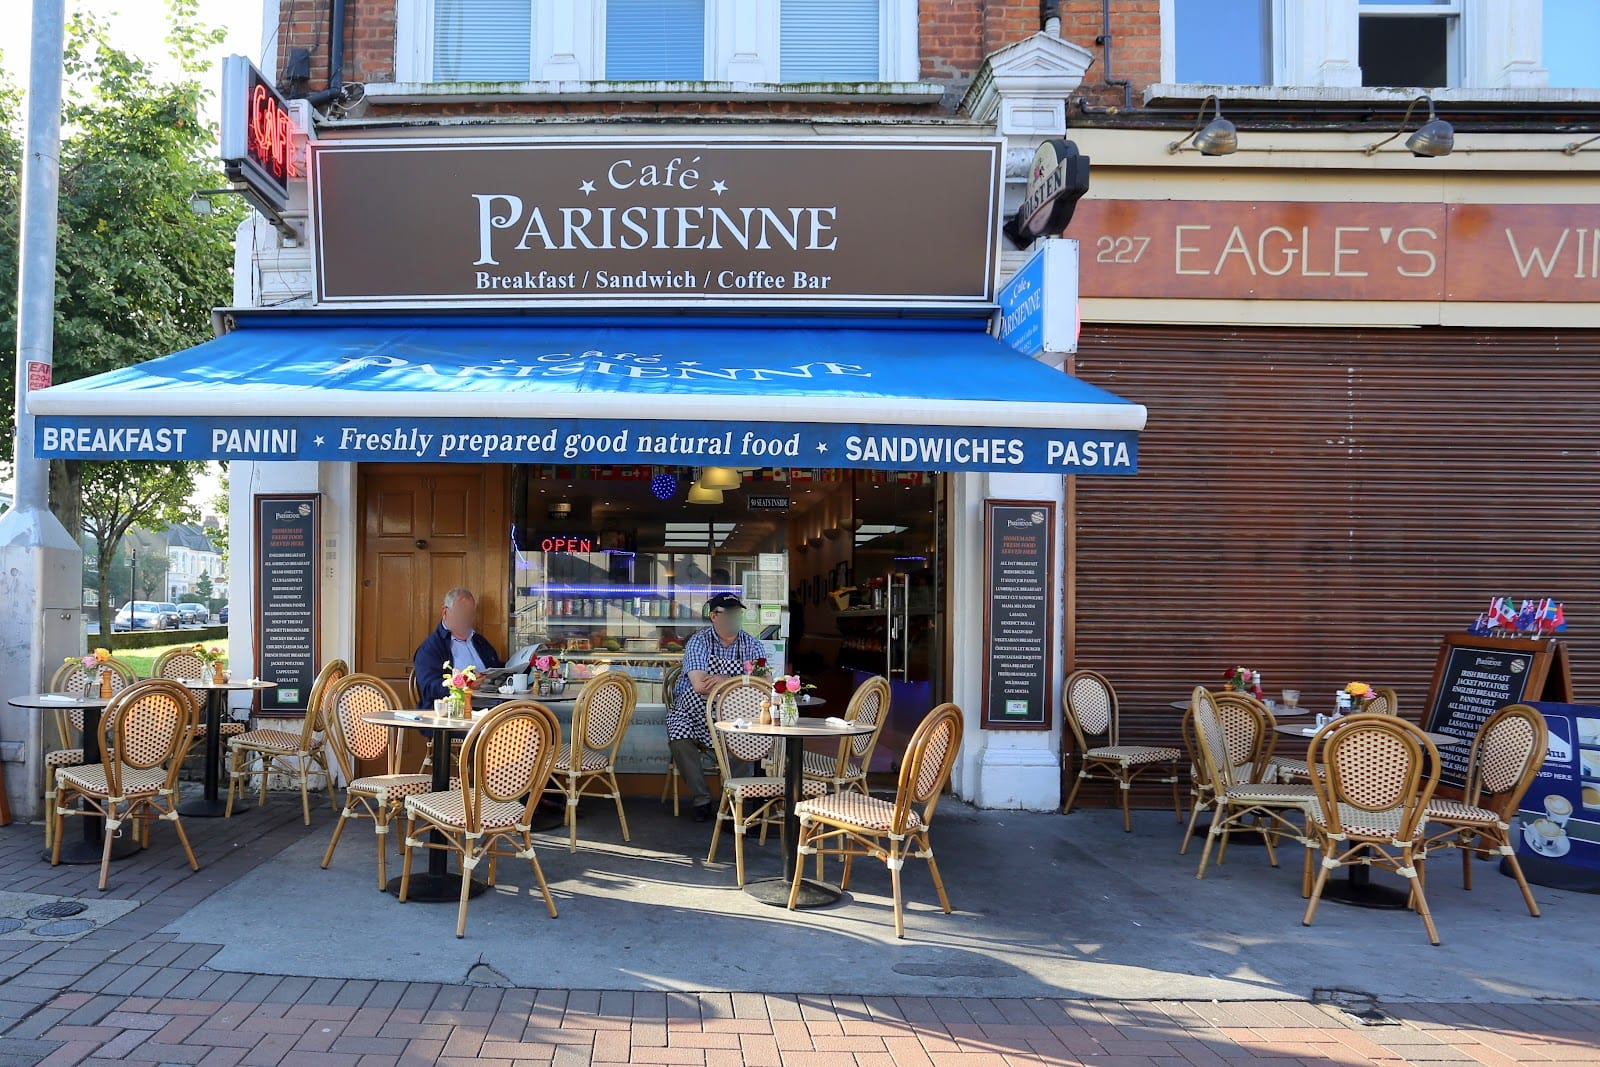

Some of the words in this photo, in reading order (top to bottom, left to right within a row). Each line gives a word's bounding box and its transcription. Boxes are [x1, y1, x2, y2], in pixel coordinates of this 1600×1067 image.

[607, 155, 701, 190] Café
[1024, 166, 1062, 220] OLSTEN
[471, 193, 839, 266] PARISIENNE
[1096, 236, 1151, 263] 227
[1175, 224, 1438, 278] EAGLE'S
[1504, 228, 1600, 278] WI
[475, 271, 576, 289] Breakfast
[596, 271, 697, 288] Sandwich
[717, 270, 786, 289] Coffee
[792, 272, 832, 289] Bar
[42, 427, 187, 452] BREAKFAST
[212, 428, 297, 454] PANINI
[338, 427, 434, 457] Freshly
[439, 429, 558, 458] prepared
[563, 430, 629, 459] good
[636, 432, 733, 456] natural
[740, 432, 801, 456] food
[845, 436, 1024, 464] SANDWICHES
[1047, 440, 1130, 466] PASTA
[542, 538, 590, 552] OPEN
[1456, 678, 1478, 686] JACKET
[1478, 680, 1509, 690] POTATOES
[1477, 672, 1510, 682] BREAKFAST
[1452, 686, 1476, 695] ENGLISH
[1476, 688, 1510, 700] BREAKFAST
[1460, 696, 1480, 704] PANINI
[1448, 719, 1474, 729] LASAGNA
[1452, 712, 1476, 720] GRILLED
